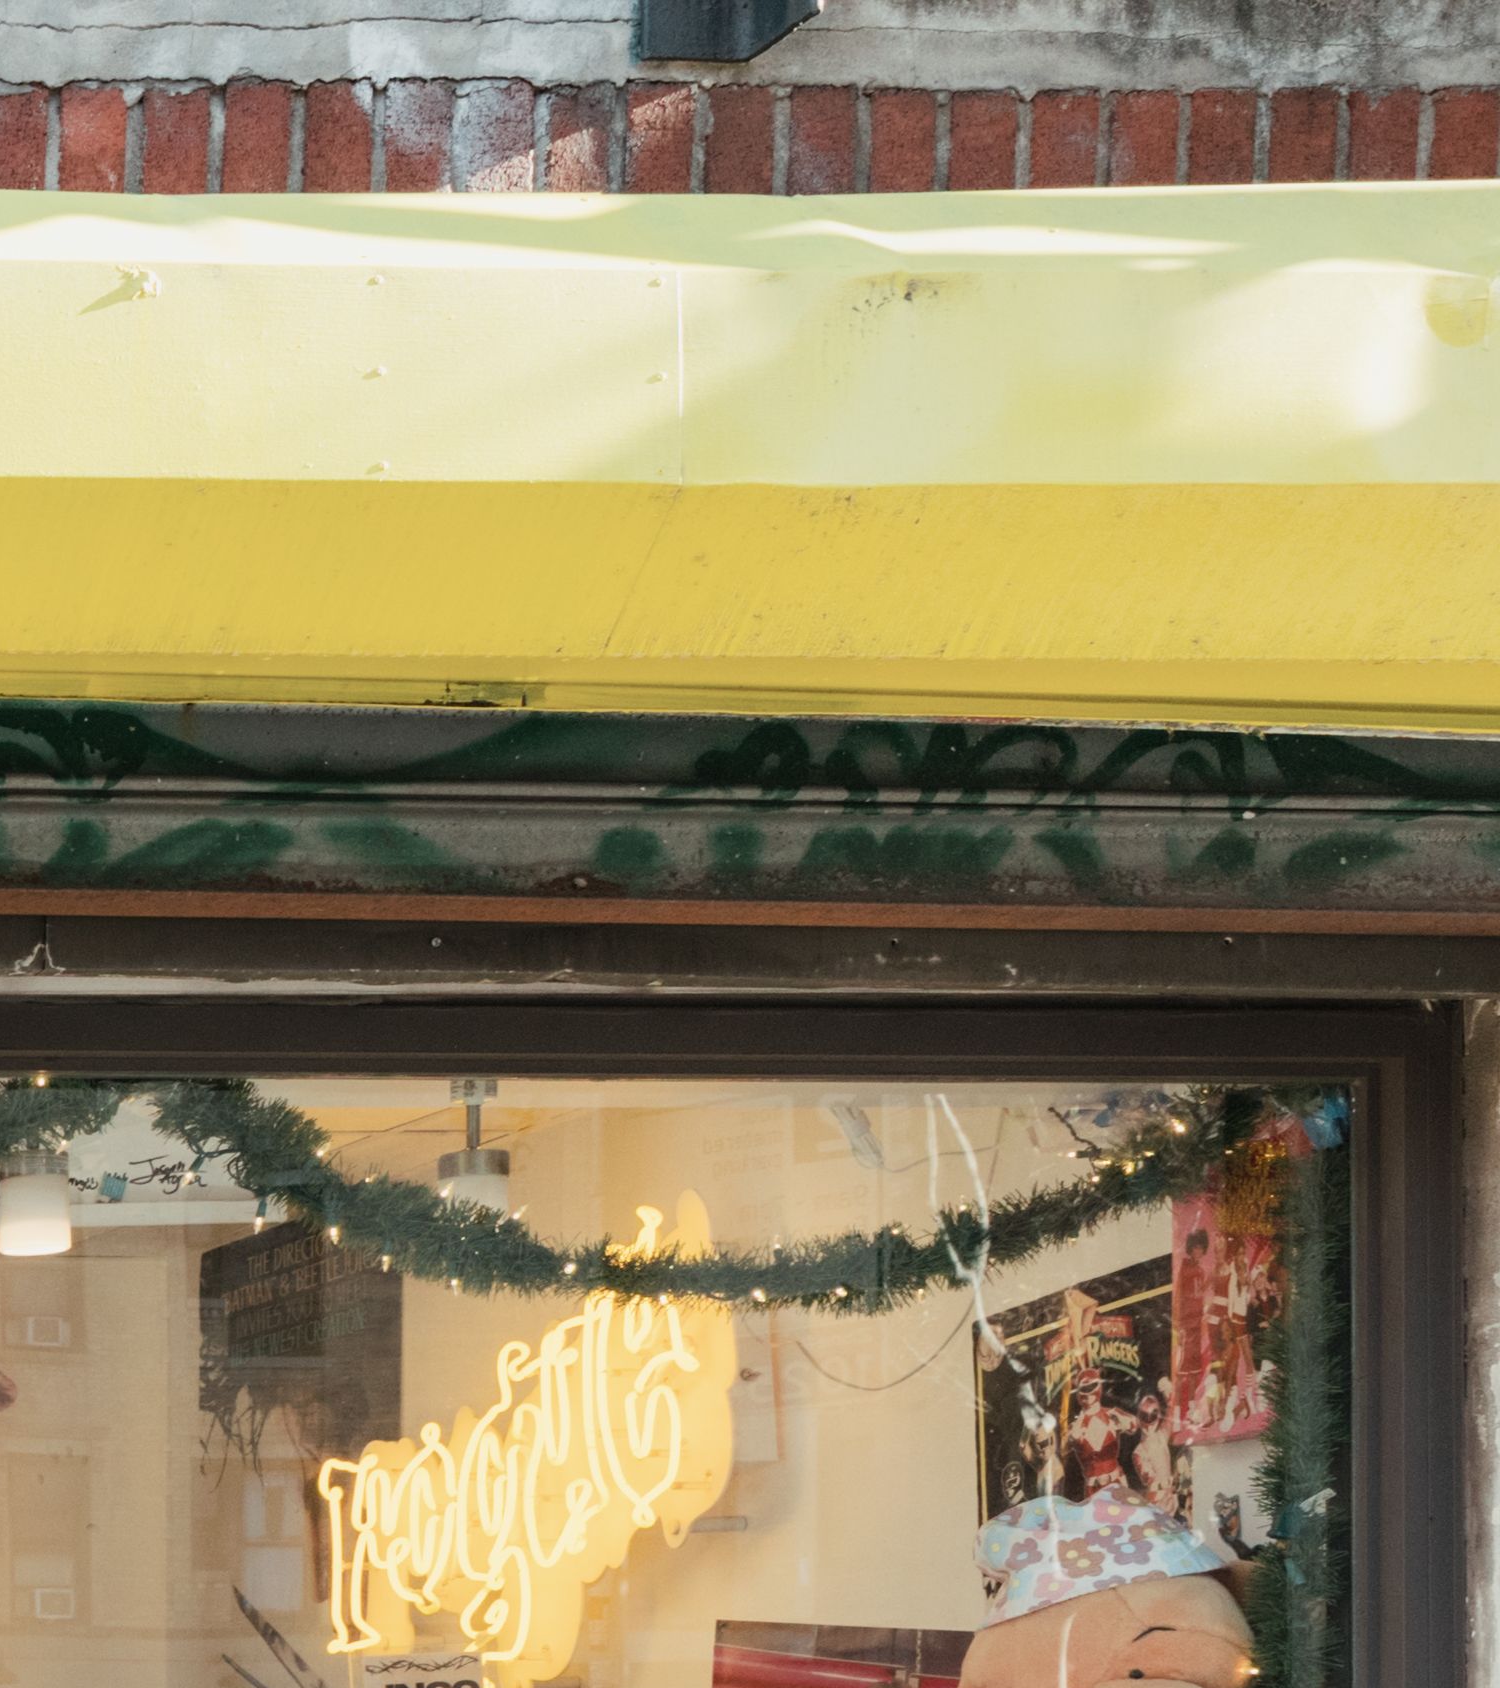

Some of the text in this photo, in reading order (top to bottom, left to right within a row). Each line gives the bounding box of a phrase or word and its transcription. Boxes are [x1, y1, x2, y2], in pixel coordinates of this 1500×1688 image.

[247, 1250, 271, 1280] THE
[221, 1277, 276, 1316] BATMAN
[1085, 1333, 1141, 1368] RANGERS
